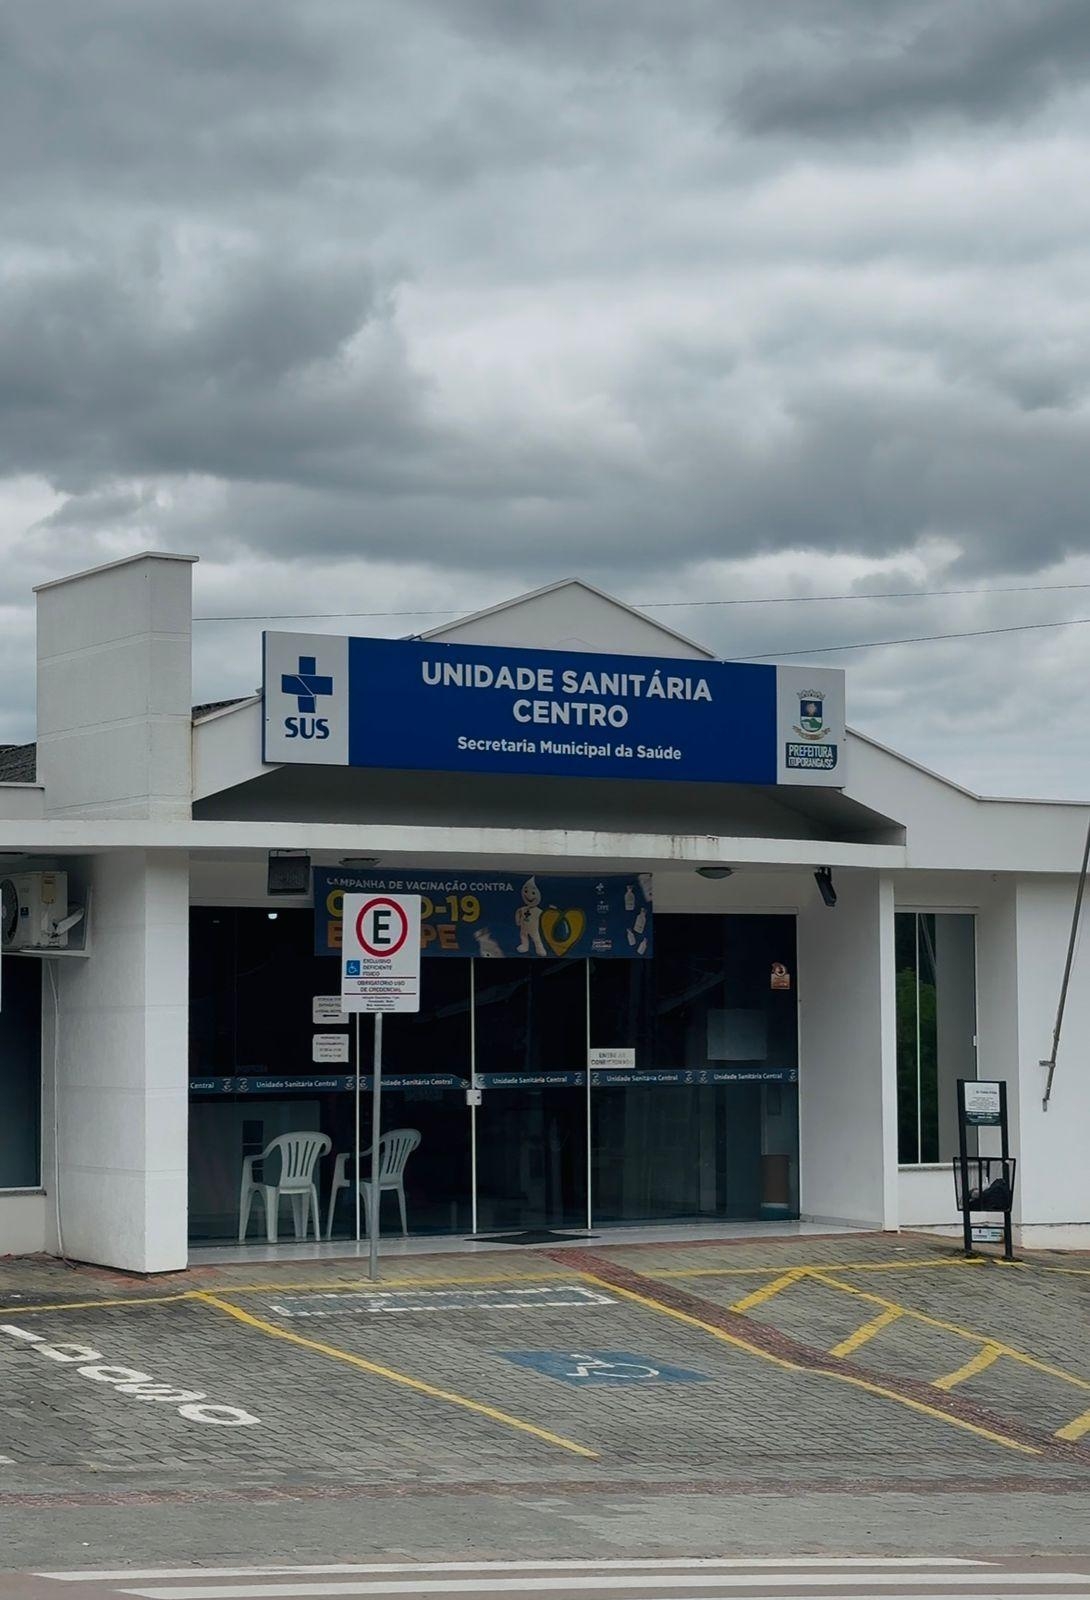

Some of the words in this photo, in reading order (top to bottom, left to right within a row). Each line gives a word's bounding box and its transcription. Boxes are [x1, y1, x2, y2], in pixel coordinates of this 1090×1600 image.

[422, 661, 554, 692] UNIDADE
[561, 669, 713, 702] SANITÁRIA
[513, 699, 628, 728] CENTRO
[284, 716, 330, 740] SUS
[457, 736, 536, 753] Secretaria
[539, 740, 611, 758] Municipal
[614, 744, 634, 757] da
[636, 745, 682, 760] Saúde
[788, 744, 834, 758] PREFEITURA
[326, 877, 386, 890] CAMPANHA
[388, 880, 403, 890] DE
[406, 880, 468, 893] VACINAÇÃO
[469, 881, 514, 892] CONTRA
[373, 910, 392, 945] E
[430, 1078, 453, 1086] Central
[492, 1077, 518, 1085] Unidade
[546, 1075, 567, 1084] Central
[606, 1074, 631, 1082] Unidade
[657, 1073, 679, 1081] Central
[763, 1071, 783, 1079] Central
[256, 1081, 283, 1089] Unidade
[284, 1080, 313, 1088] Sanitária
